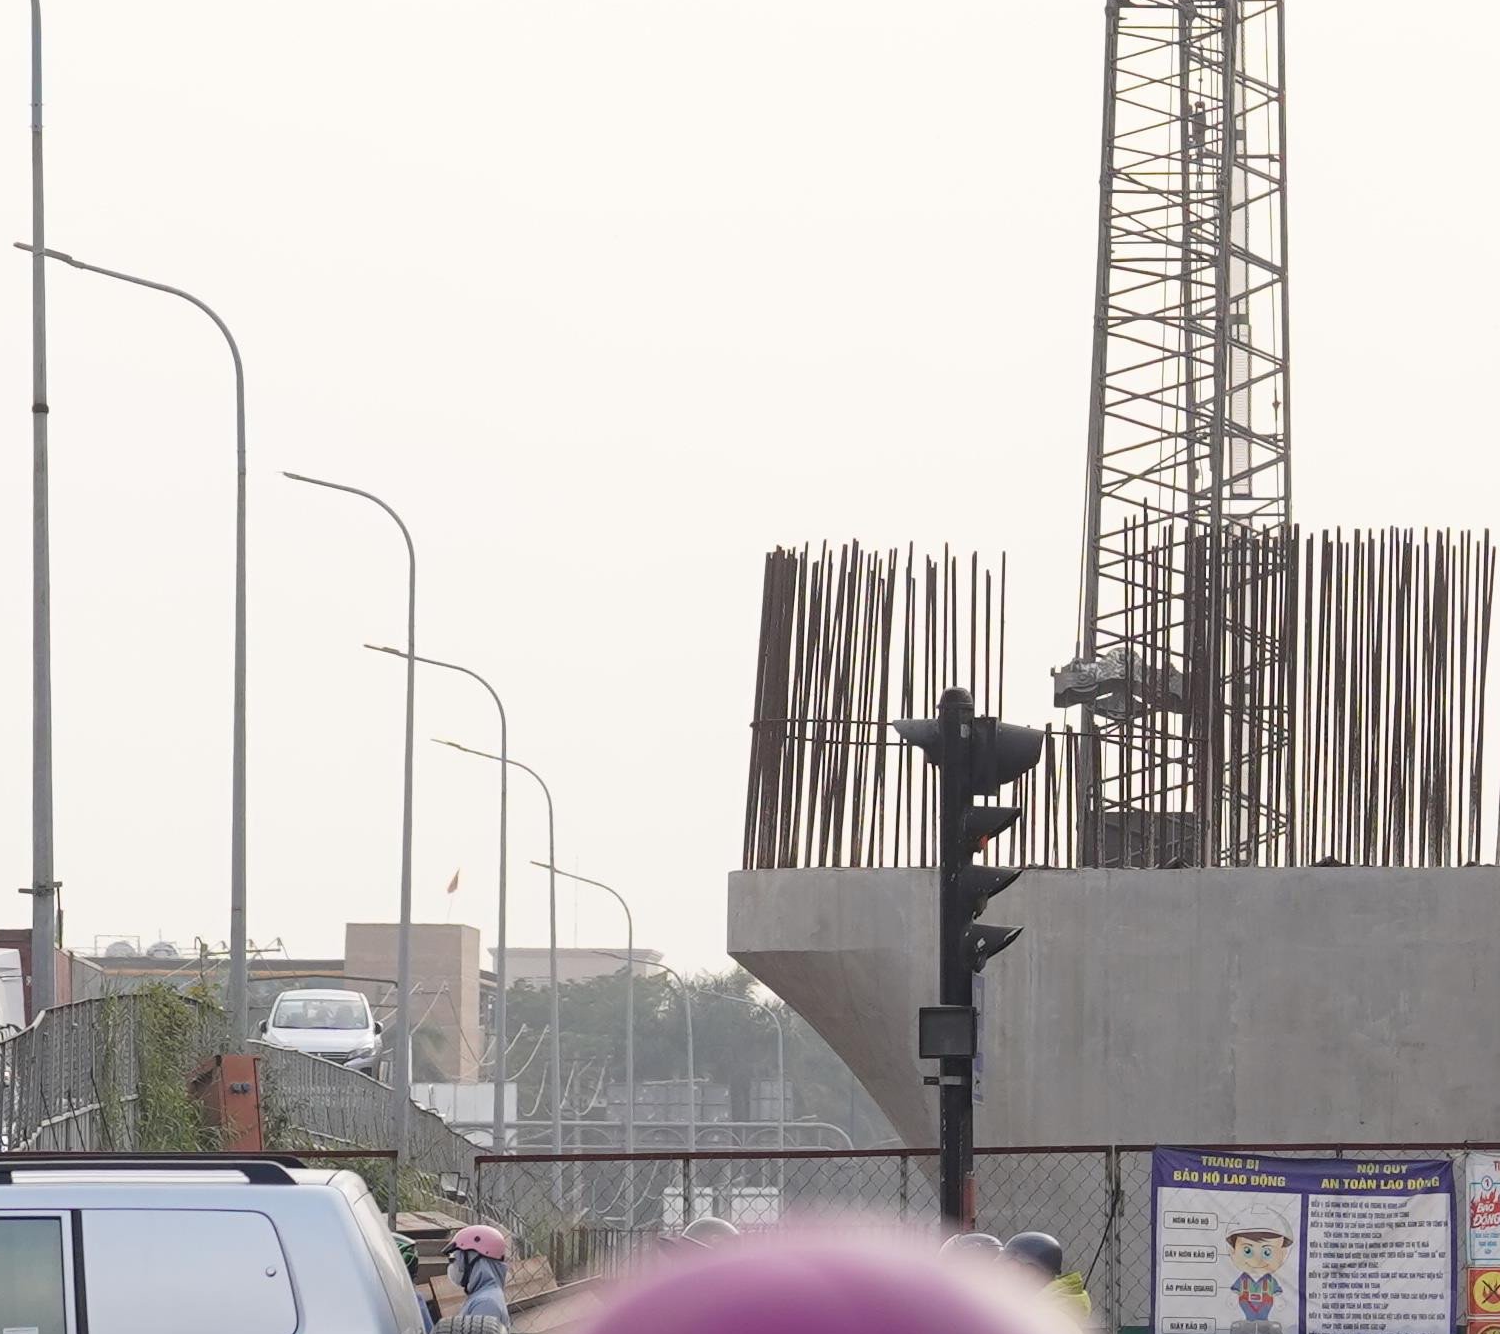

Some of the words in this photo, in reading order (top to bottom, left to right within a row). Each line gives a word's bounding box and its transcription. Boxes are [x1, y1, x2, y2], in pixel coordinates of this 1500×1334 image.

[1201, 1156, 1242, 1168] TRANG
[1246, 1159, 1259, 1171] BỊ
[1357, 1163, 1379, 1176] NỘI
[1383, 1165, 1408, 1174] QUY
[1173, 1168, 1199, 1181] BẢO
[1203, 1171, 1220, 1186] HỘ
[1224, 1174, 1247, 1185] LAO
[1251, 1174, 1286, 1187] ĐỘNG
[1321, 1179, 1339, 1189] AN
[1344, 1176, 1376, 1189] TOÀN
[1380, 1180, 1403, 1190] LAO
[1485, 1179, 1490, 1187] 1
